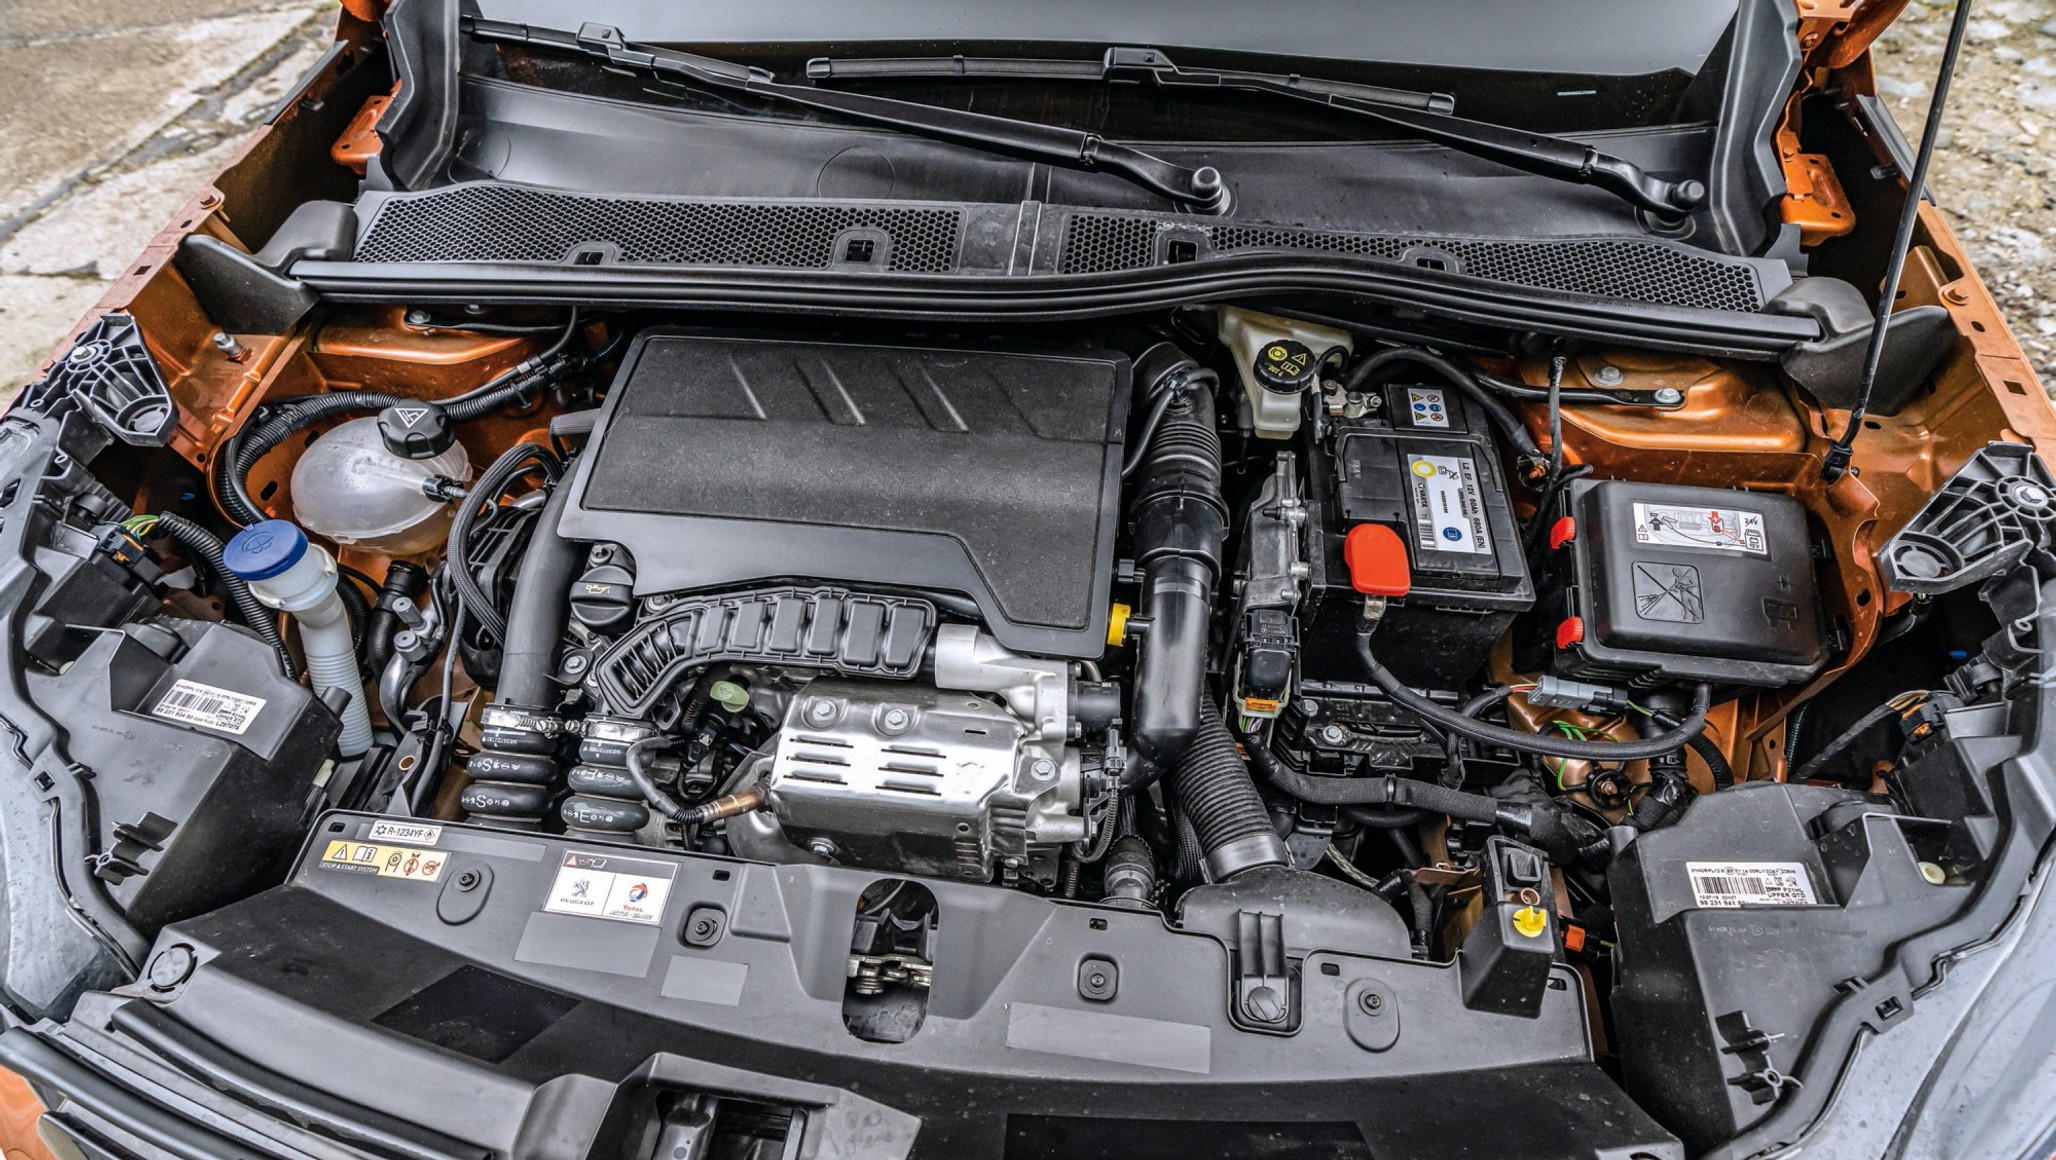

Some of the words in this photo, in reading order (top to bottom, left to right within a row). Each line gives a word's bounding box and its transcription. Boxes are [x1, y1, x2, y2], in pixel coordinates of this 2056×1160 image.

[1462, 462, 1470, 470] L2
[1467, 484, 1476, 496] 12V
[1420, 490, 1428, 508] VARTA
[1469, 498, 1479, 515] 60Ah
[1476, 535, 1486, 549] (EN)
[388, 826, 424, 838] R-1234YF
[560, 898, 594, 906] PEUGEOT
[623, 904, 644, 913] TOTAL
